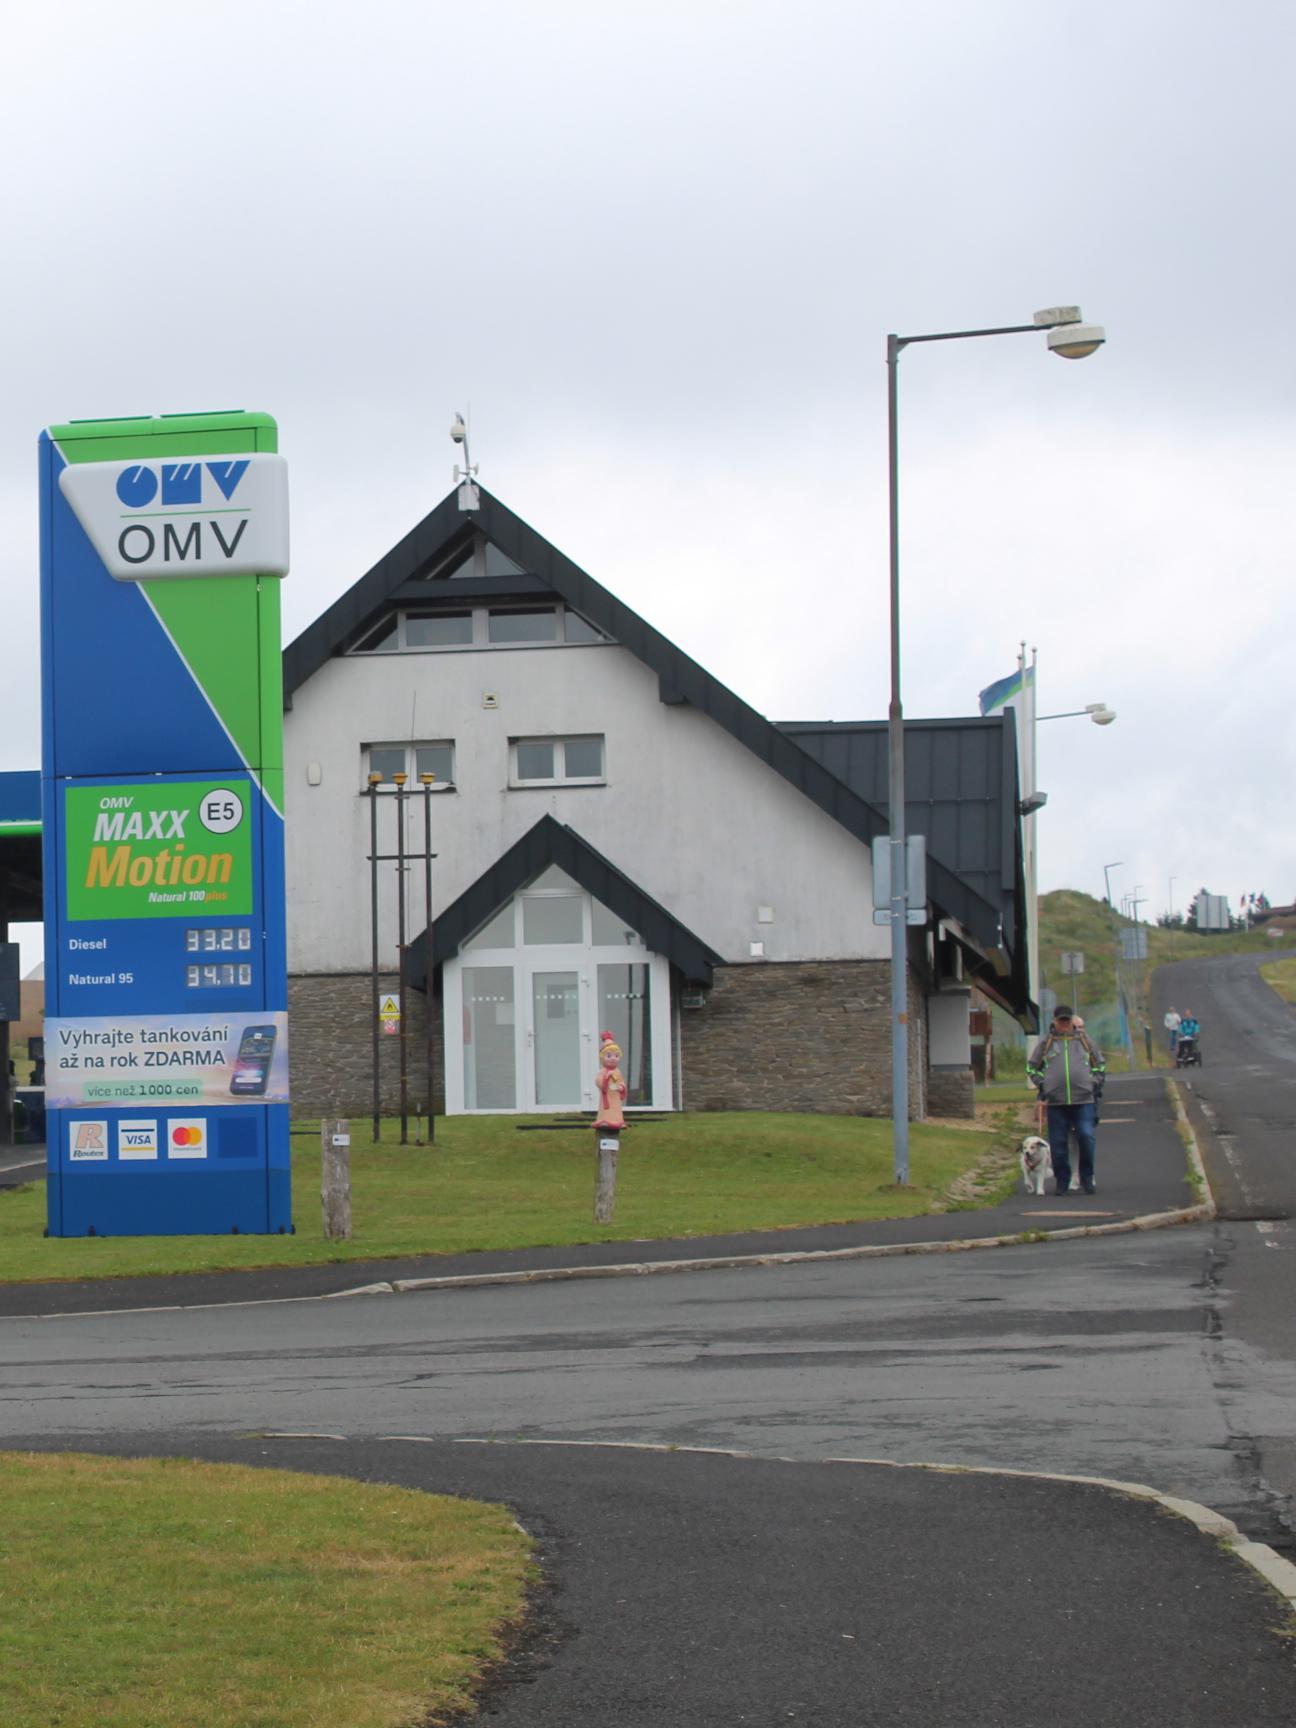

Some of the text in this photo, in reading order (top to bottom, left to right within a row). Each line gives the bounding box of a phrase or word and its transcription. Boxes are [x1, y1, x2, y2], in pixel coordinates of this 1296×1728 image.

[118, 519, 249, 564] OMV
[100, 797, 134, 810] OMV
[207, 802, 235, 821] E5
[93, 810, 190, 842] MAXX
[85, 843, 233, 888] Motion
[148, 892, 186, 903] Natural
[69, 938, 107, 950] Diesel
[69, 973, 115, 985] Natural
[118, 973, 133, 984] 95
[59, 1025, 229, 1048] Vyhrajte tankování
[59, 1050, 226, 1068] až na rok ZDARMA
[88, 1087, 111, 1097] více
[115, 1085, 136, 1096] než
[176, 1085, 199, 1095] cen
[126, 1135, 152, 1145] VISA
